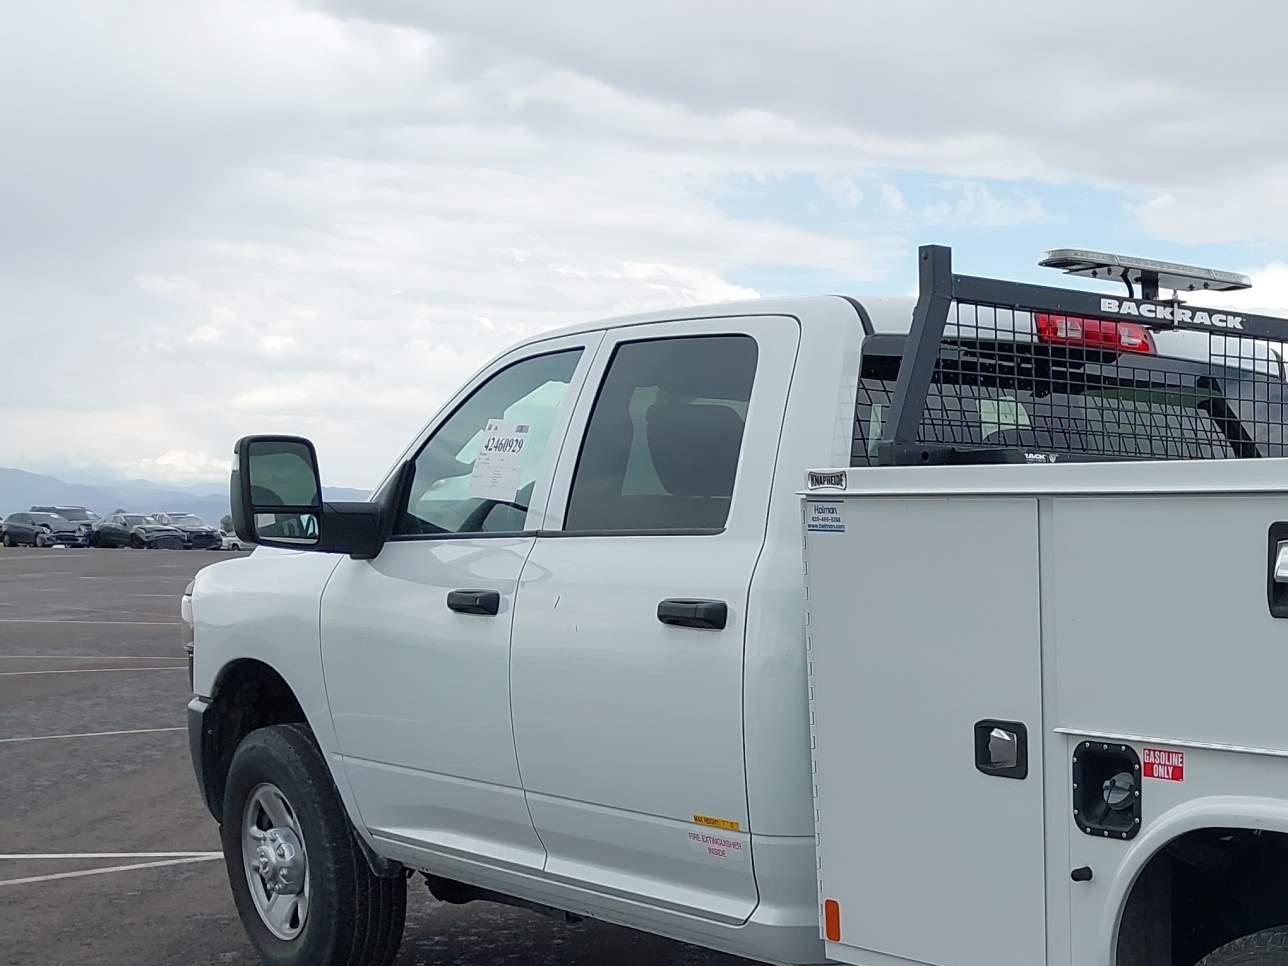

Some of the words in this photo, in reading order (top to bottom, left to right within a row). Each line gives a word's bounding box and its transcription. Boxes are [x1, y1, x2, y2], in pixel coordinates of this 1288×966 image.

[1100, 298, 1243, 329] BACKRACK
[484, 437, 524, 453] 42460929
[810, 473, 844, 488] KNAPHEIDE
[814, 504, 838, 515] Holman
[1144, 750, 1183, 767] GASOLINE
[1153, 764, 1174, 779] ONLY
